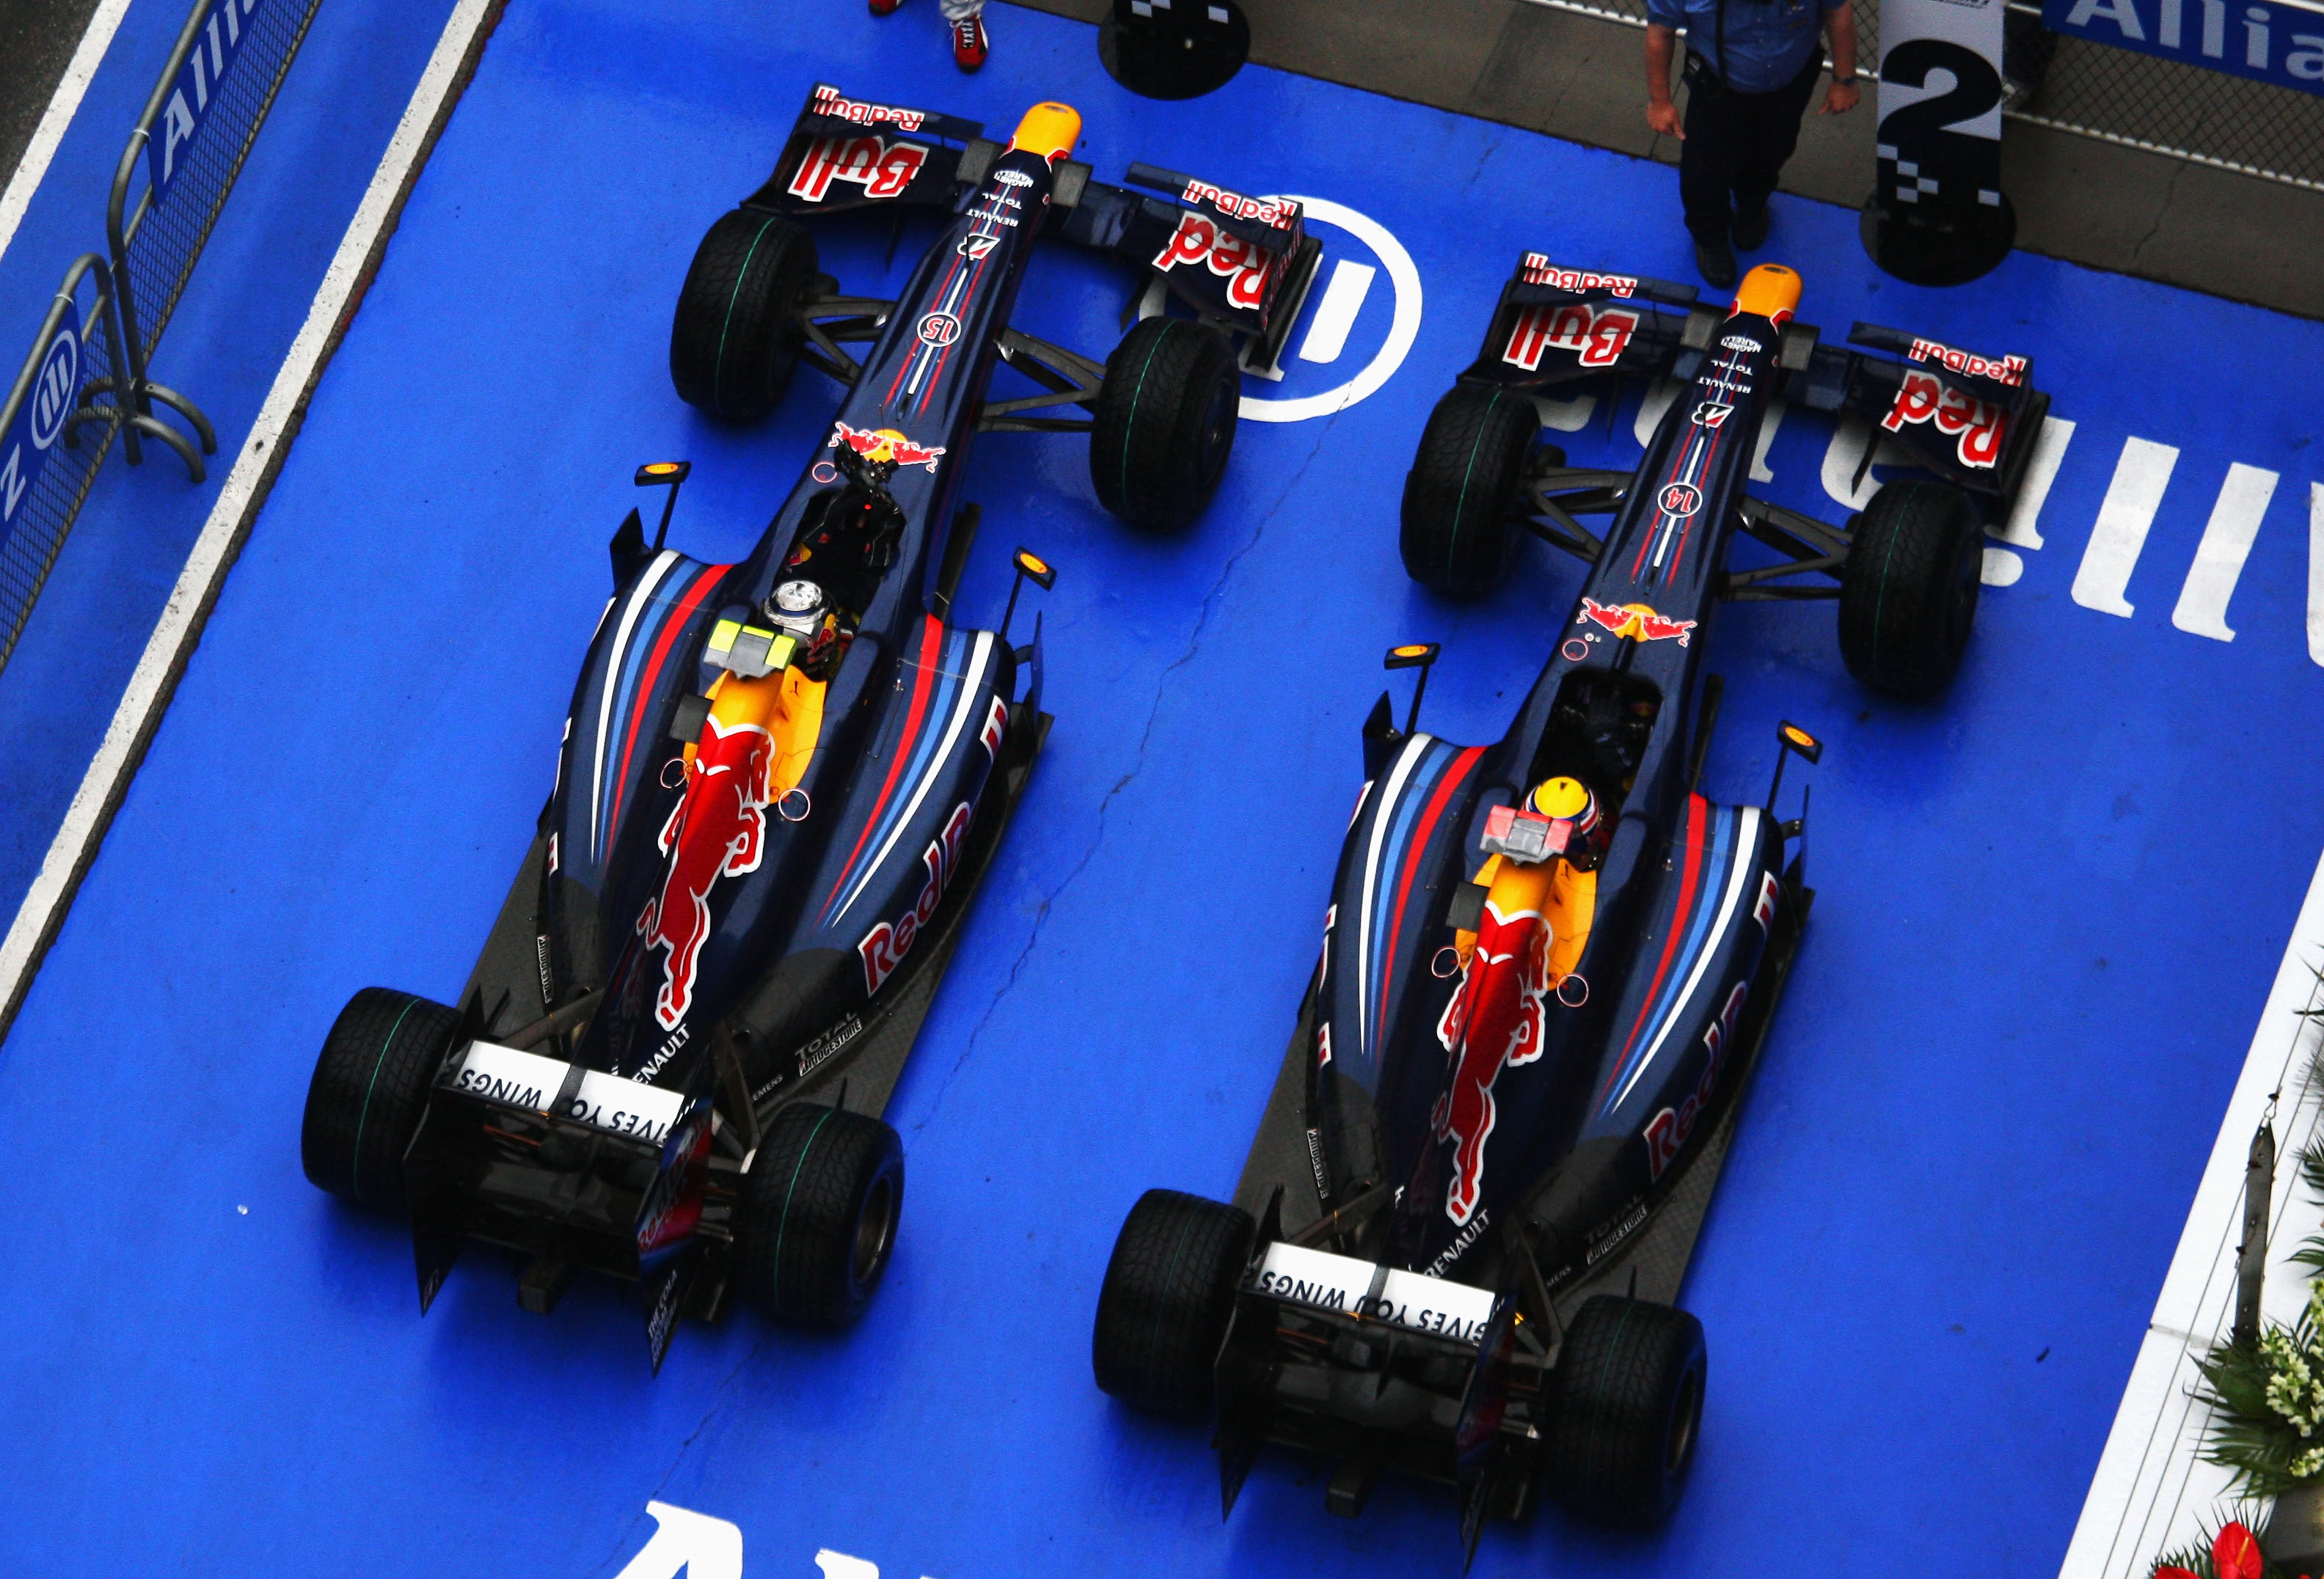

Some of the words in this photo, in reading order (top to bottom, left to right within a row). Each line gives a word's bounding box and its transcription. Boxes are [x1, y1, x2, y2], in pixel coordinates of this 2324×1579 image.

[163, 0, 255, 186] Alli
[1877, 39, 2002, 145] 2
[787, 136, 929, 202] Bull
[965, 208, 1019, 227] RENAULT
[982, 192, 1022, 210] TOTAL
[1152, 210, 1278, 310] Red
[923, 317, 954, 343] 15
[1502, 304, 1640, 372] Bull
[1696, 376, 1752, 394] RENAULT
[1710, 359, 1753, 376] TOTAL
[1881, 370, 2009, 469] Red
[1666, 487, 1695, 513] 14
[632, 1022, 690, 1084] ENAULT
[458, 1069, 542, 1110] WINGS
[752, 1074, 783, 1102] EMENS
[609, 1110, 672, 1144] IVES
[1260, 1271, 1346, 1311] WINGS
